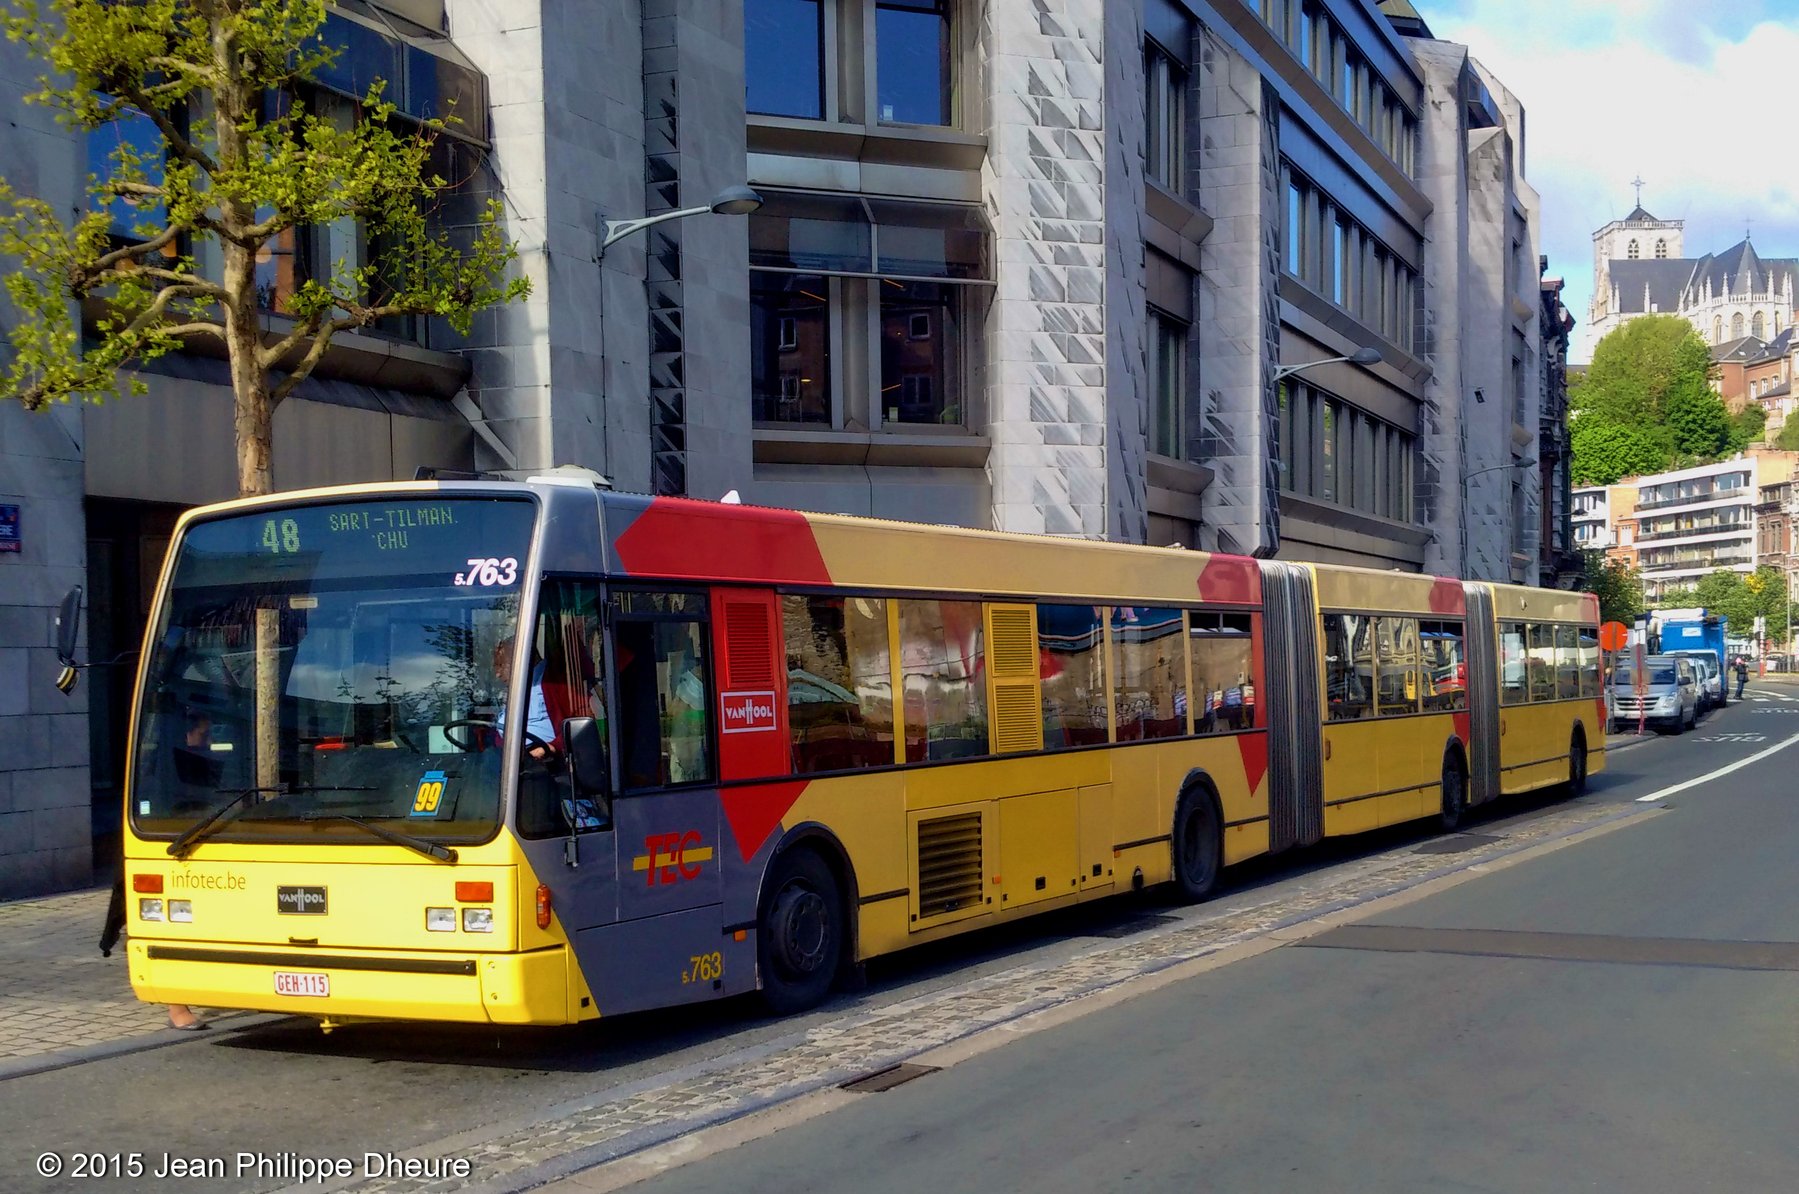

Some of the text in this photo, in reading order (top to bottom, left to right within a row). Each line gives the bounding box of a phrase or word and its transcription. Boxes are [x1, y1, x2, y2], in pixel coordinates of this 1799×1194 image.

[263, 519, 300, 553] 48
[378, 531, 408, 549] CHU
[454, 557, 518, 586] 5.763
[414, 782, 442, 811] 99
[645, 830, 702, 887] TEC
[172, 870, 246, 890] infotec.be
